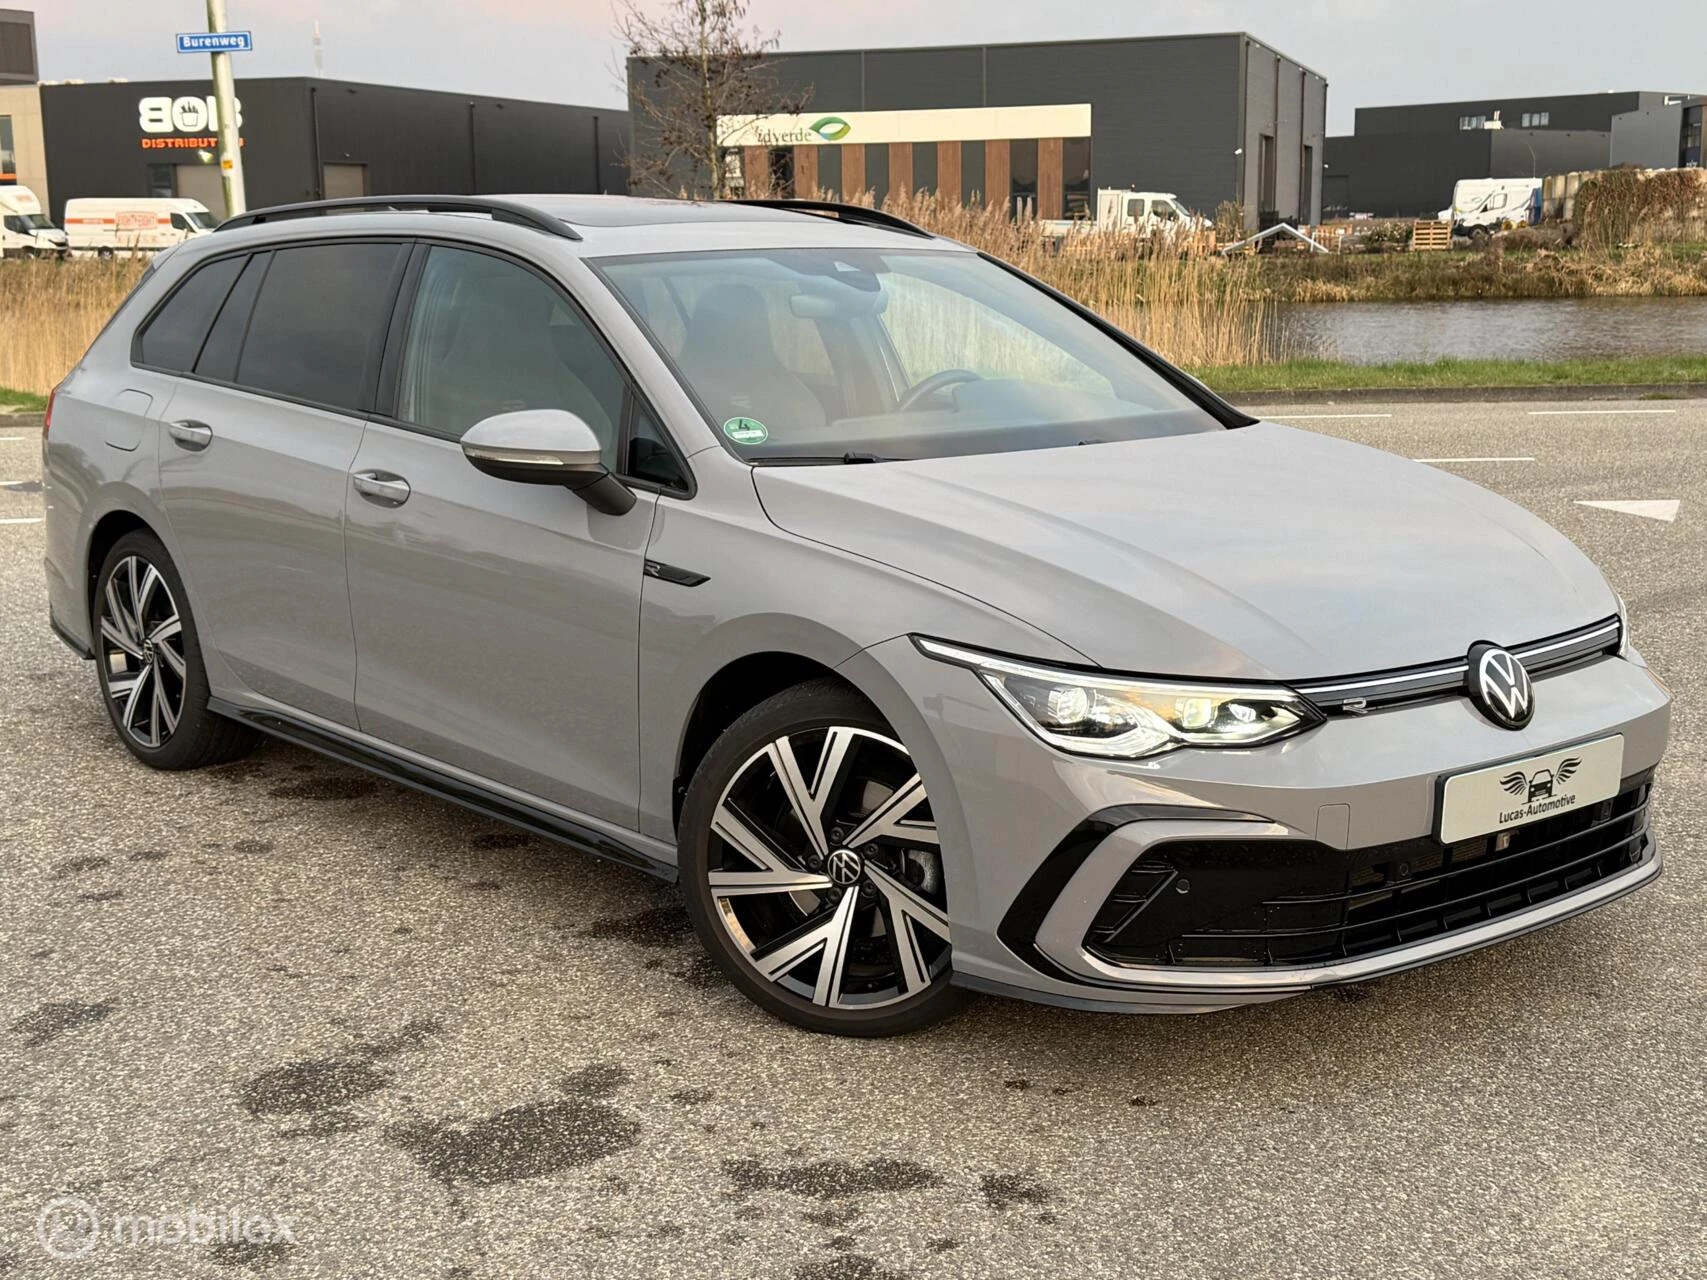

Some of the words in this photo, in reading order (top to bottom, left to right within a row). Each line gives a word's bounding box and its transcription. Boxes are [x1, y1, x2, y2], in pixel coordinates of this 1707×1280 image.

[183, 36, 245, 48] Burenweg
[141, 137, 244, 149] DISTRIBUT
[1498, 794, 1576, 824] Lucas-Automotive
